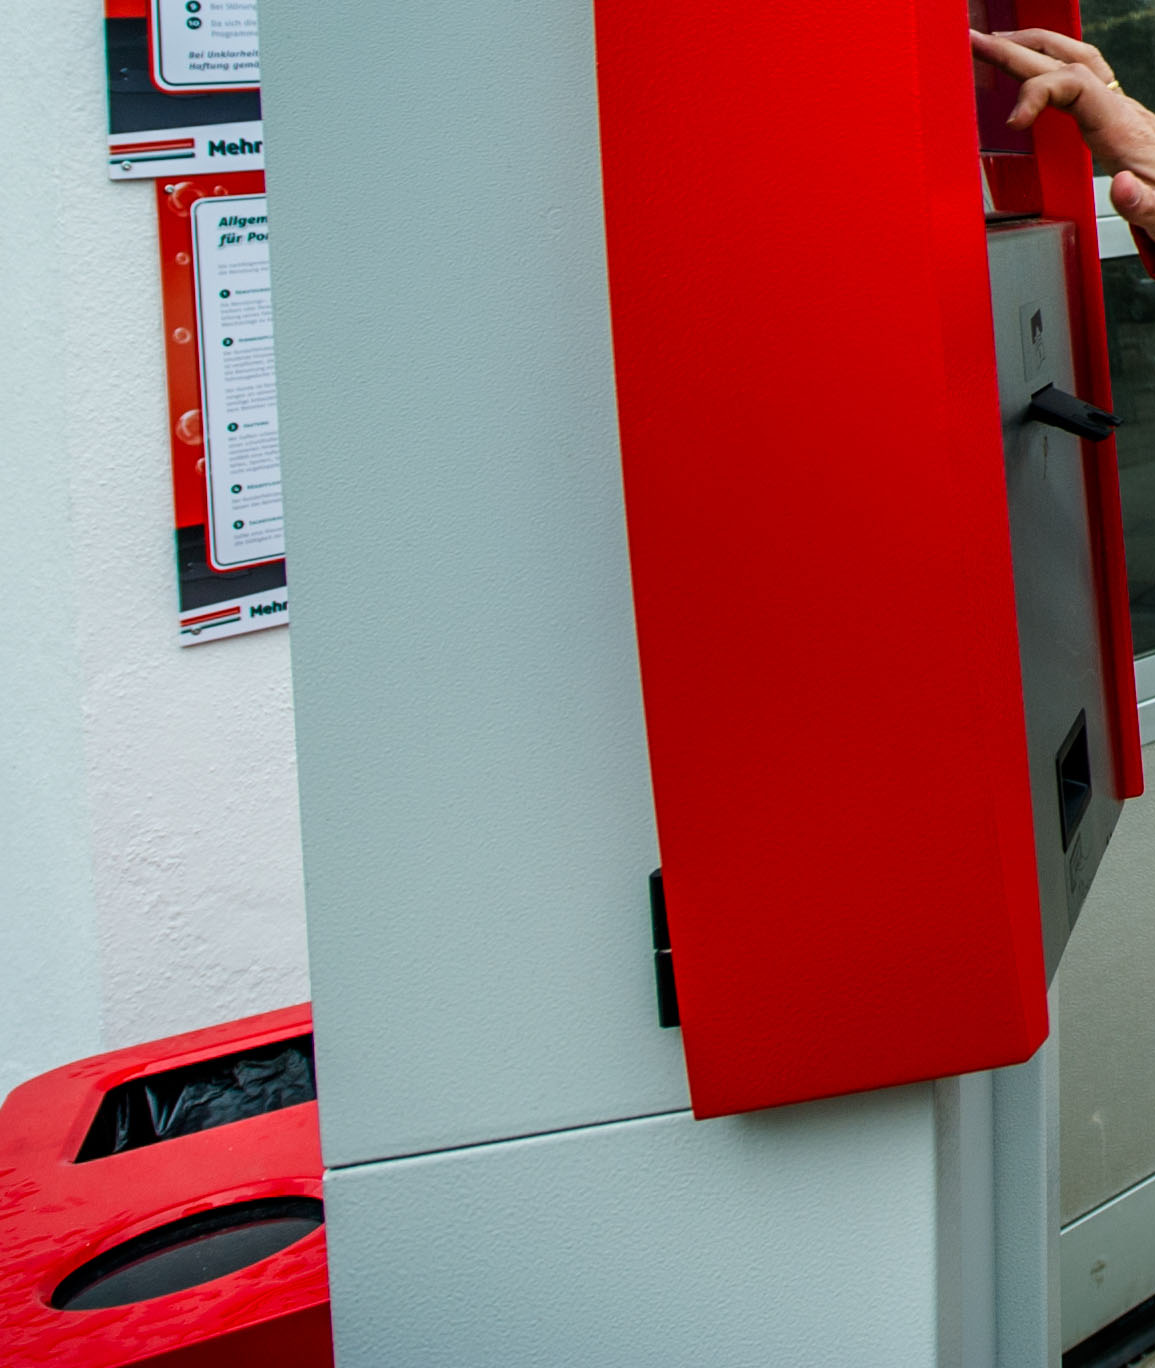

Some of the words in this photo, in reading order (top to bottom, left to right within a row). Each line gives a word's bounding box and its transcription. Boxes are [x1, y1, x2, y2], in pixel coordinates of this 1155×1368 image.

[189, 50, 204, 60] Bei
[189, 61, 229, 73] Haftung
[208, 137, 263, 158] Mehr
[218, 232, 243, 248] für
[250, 600, 288, 621] Mehr
